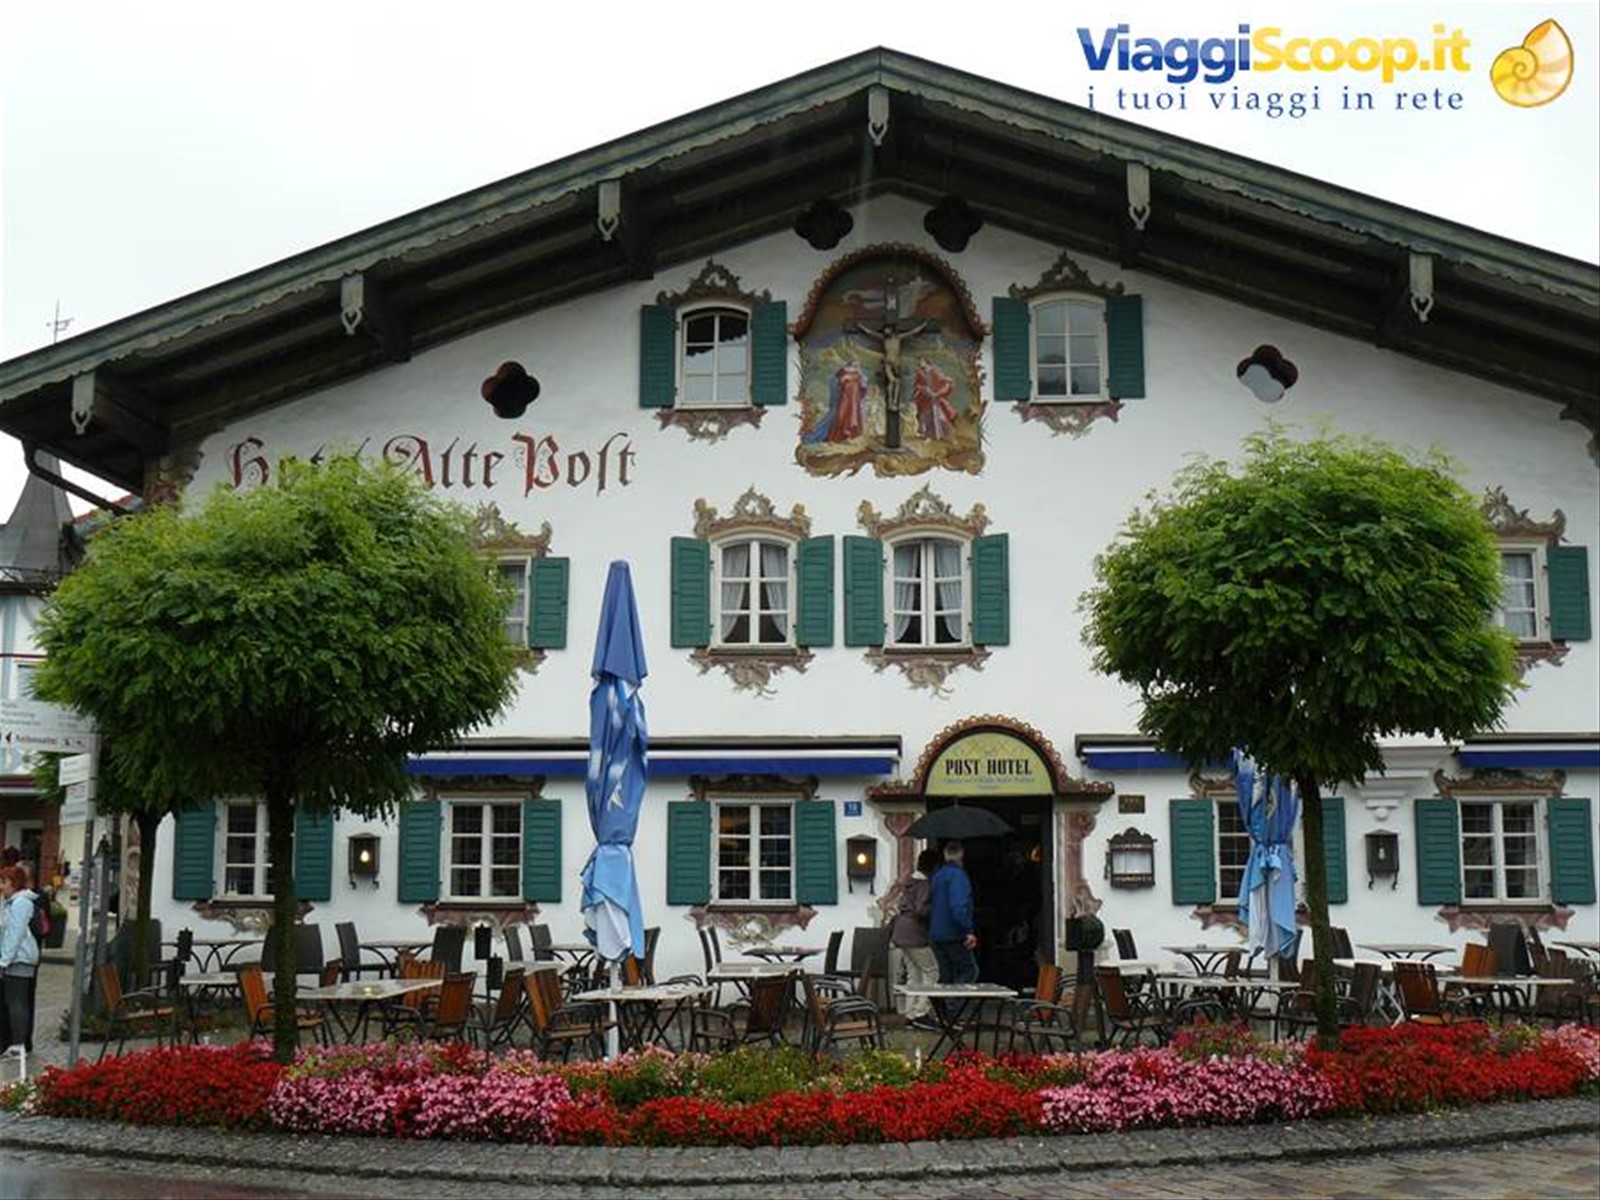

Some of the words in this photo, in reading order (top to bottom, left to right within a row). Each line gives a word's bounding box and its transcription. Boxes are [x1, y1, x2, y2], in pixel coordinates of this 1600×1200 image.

[383, 433, 506, 488] Alte
[945, 759, 981, 775] POST
[987, 759, 1032, 775] HOTEL
